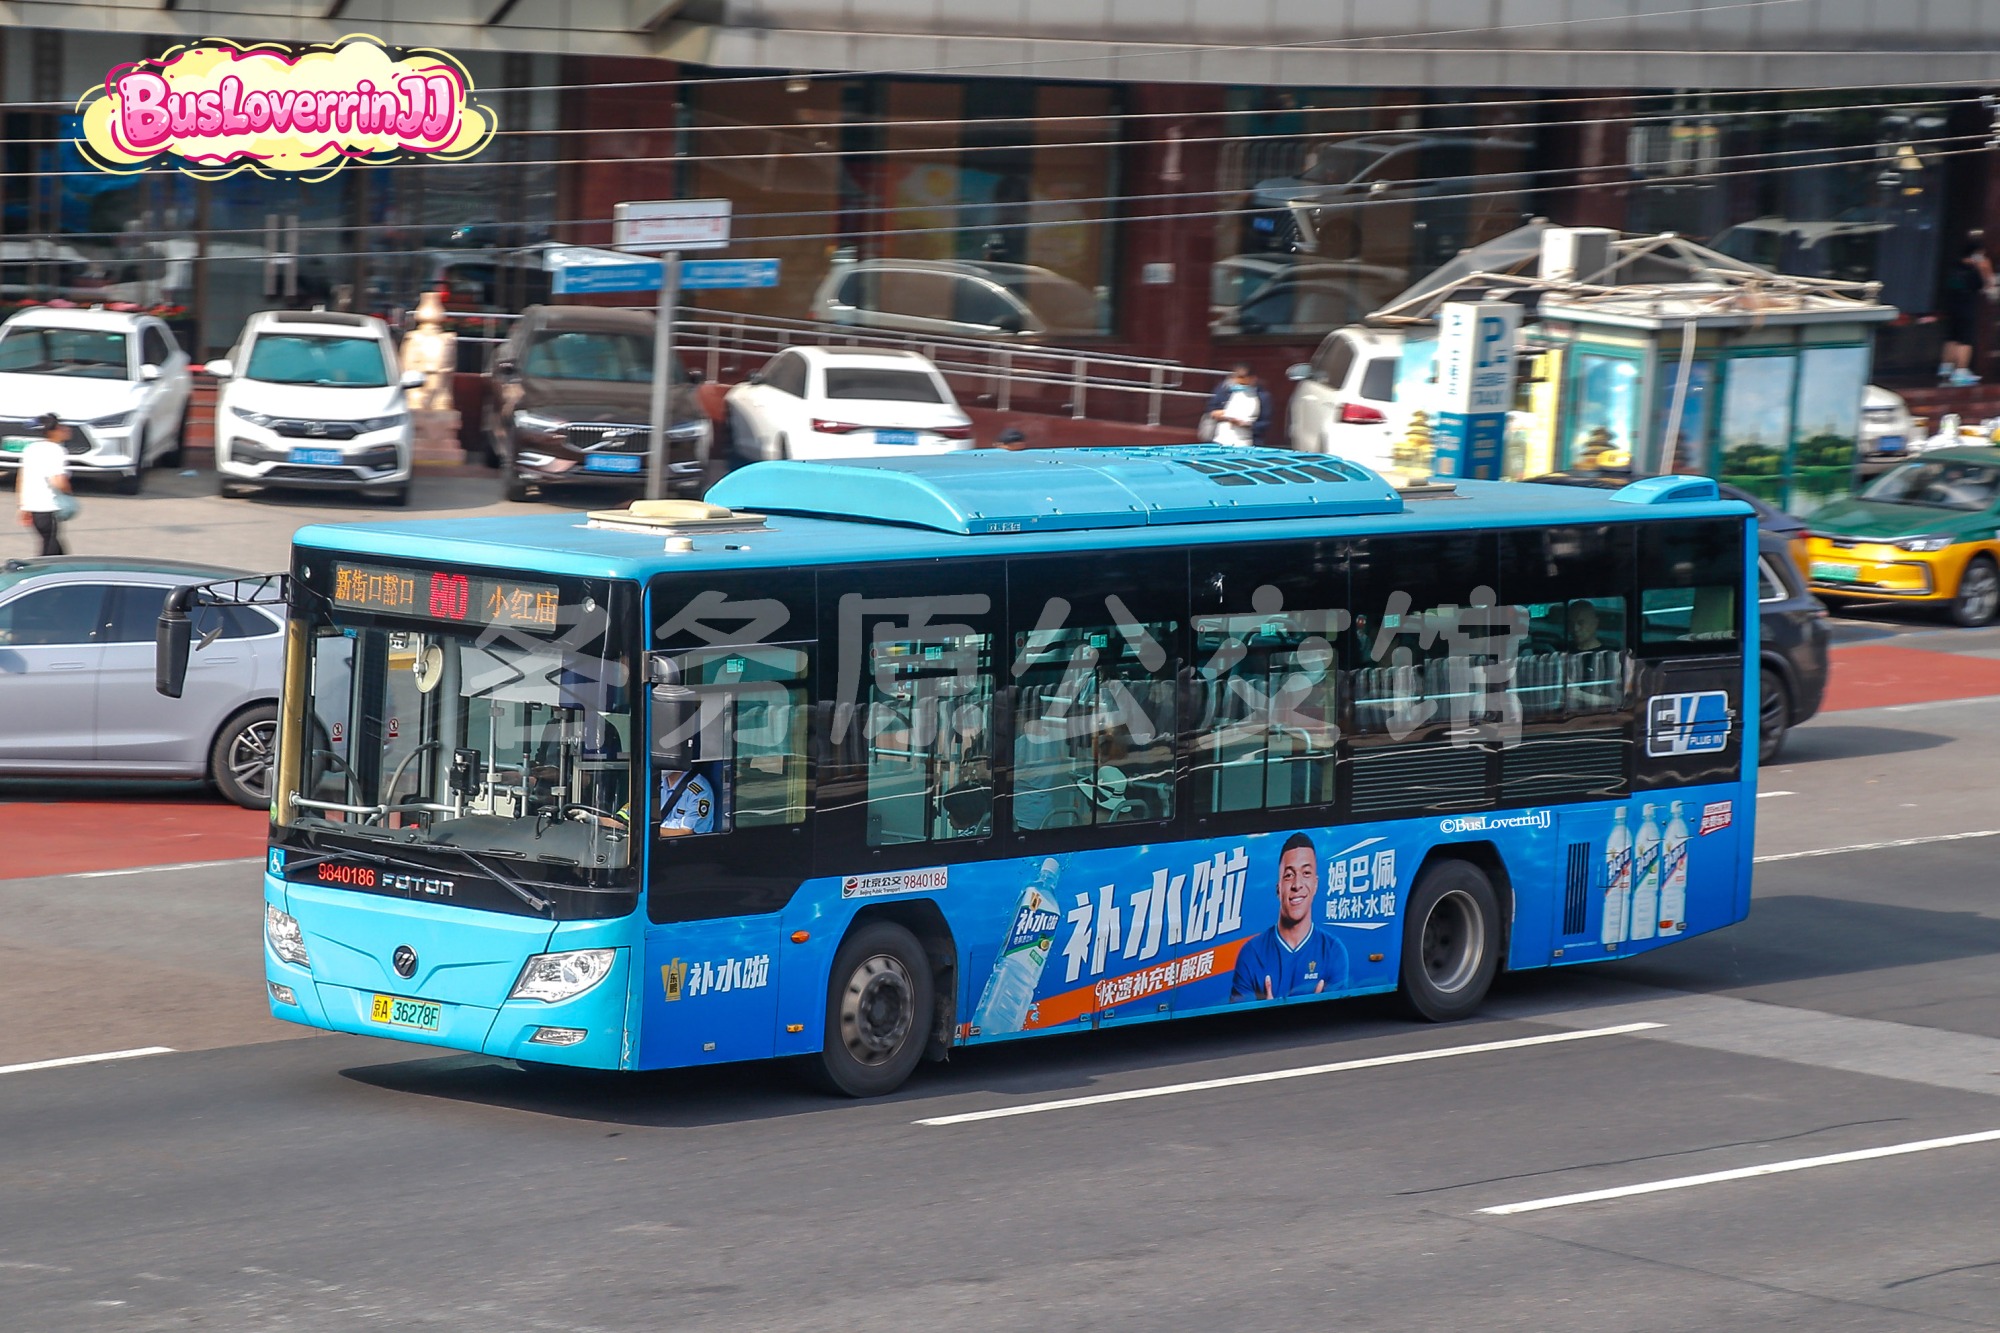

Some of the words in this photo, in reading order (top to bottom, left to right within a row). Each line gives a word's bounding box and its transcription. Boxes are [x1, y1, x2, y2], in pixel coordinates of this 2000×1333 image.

[429, 571, 468, 620] 80
[486, 585, 559, 625] 小红庙
[1689, 735, 1712, 746] PLUG
[318, 863, 375, 887] 9840186
[382, 872, 454, 896] FOTON
[861, 876, 901, 889] 北京公交
[904, 872, 947, 889] 9840186
[1327, 849, 1397, 896] 姆巴佩
[860, 889, 872, 897] Beijing
[883, 886, 901, 894] Transport
[1326, 892, 1396, 919] 喊你补水啦
[1015, 909, 1059, 936] 补水啦
[1062, 846, 1249, 983] 补水啦
[688, 954, 770, 997] 补水啦
[1098, 950, 1215, 1008] 快速补充电解质
